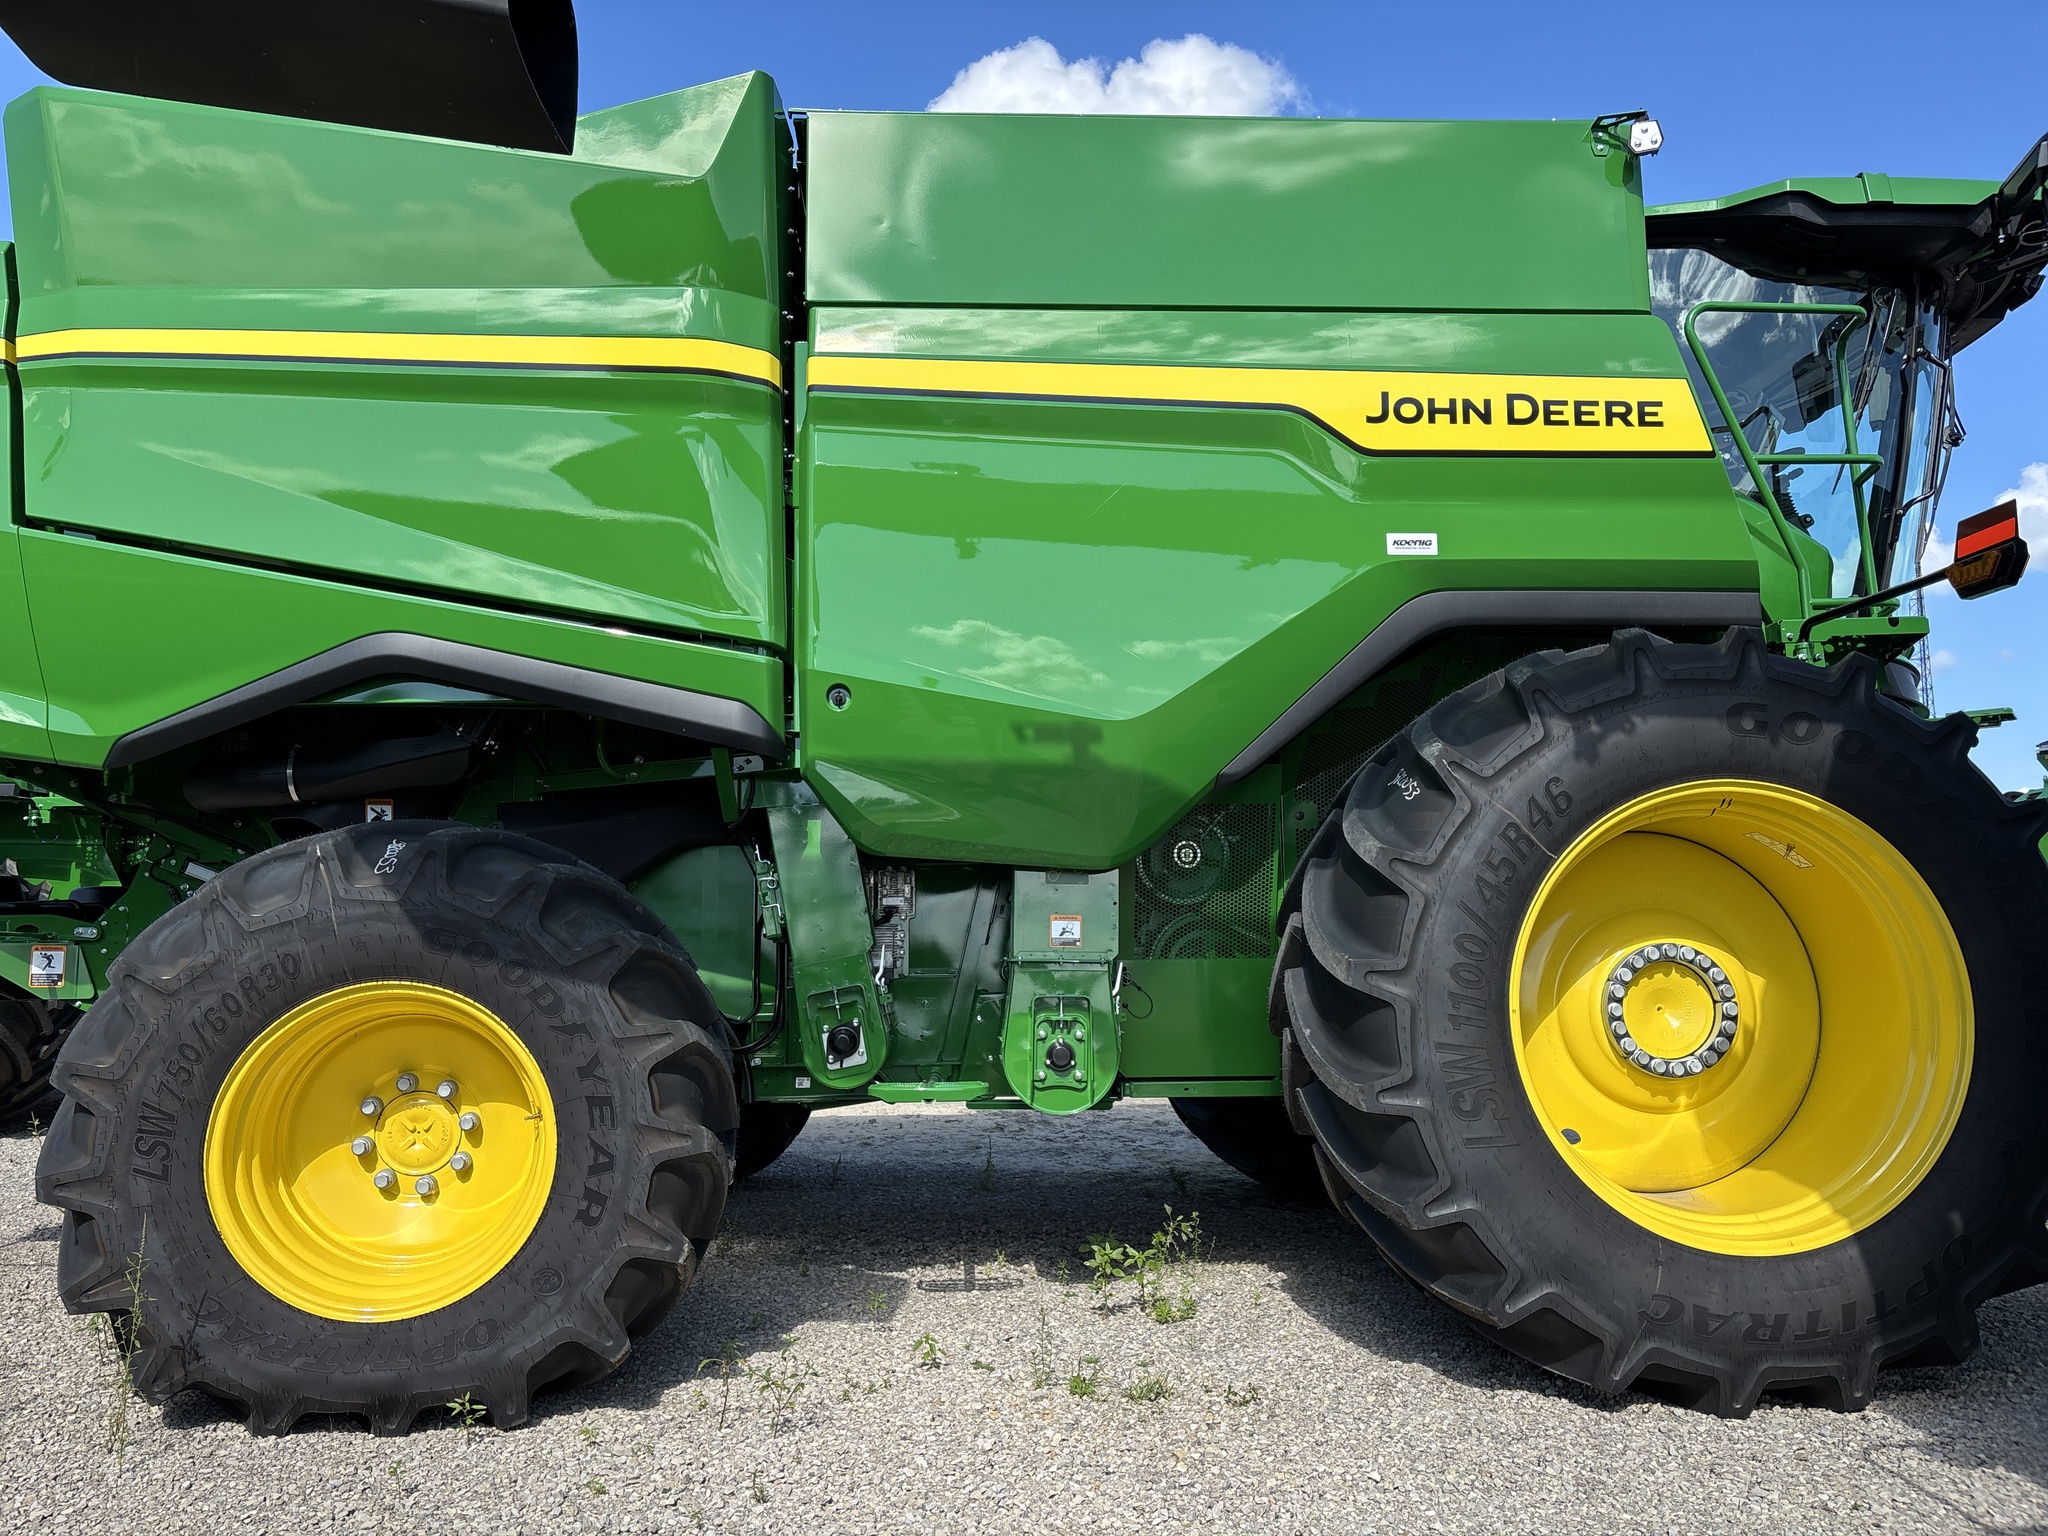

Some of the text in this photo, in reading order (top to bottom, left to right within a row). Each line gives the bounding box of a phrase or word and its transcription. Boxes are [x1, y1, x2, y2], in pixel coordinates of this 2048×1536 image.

[1366, 391, 1664, 427] JOHN DEERE
[1434, 776, 1574, 1150] LSW 1100/45R46
[130, 952, 301, 1186] LSW 750/60R30
[420, 926, 618, 1229] GOODYEAR
[185, 1294, 501, 1375] OPTITRAC
[1637, 1233, 1974, 1345] OPTITRAC
